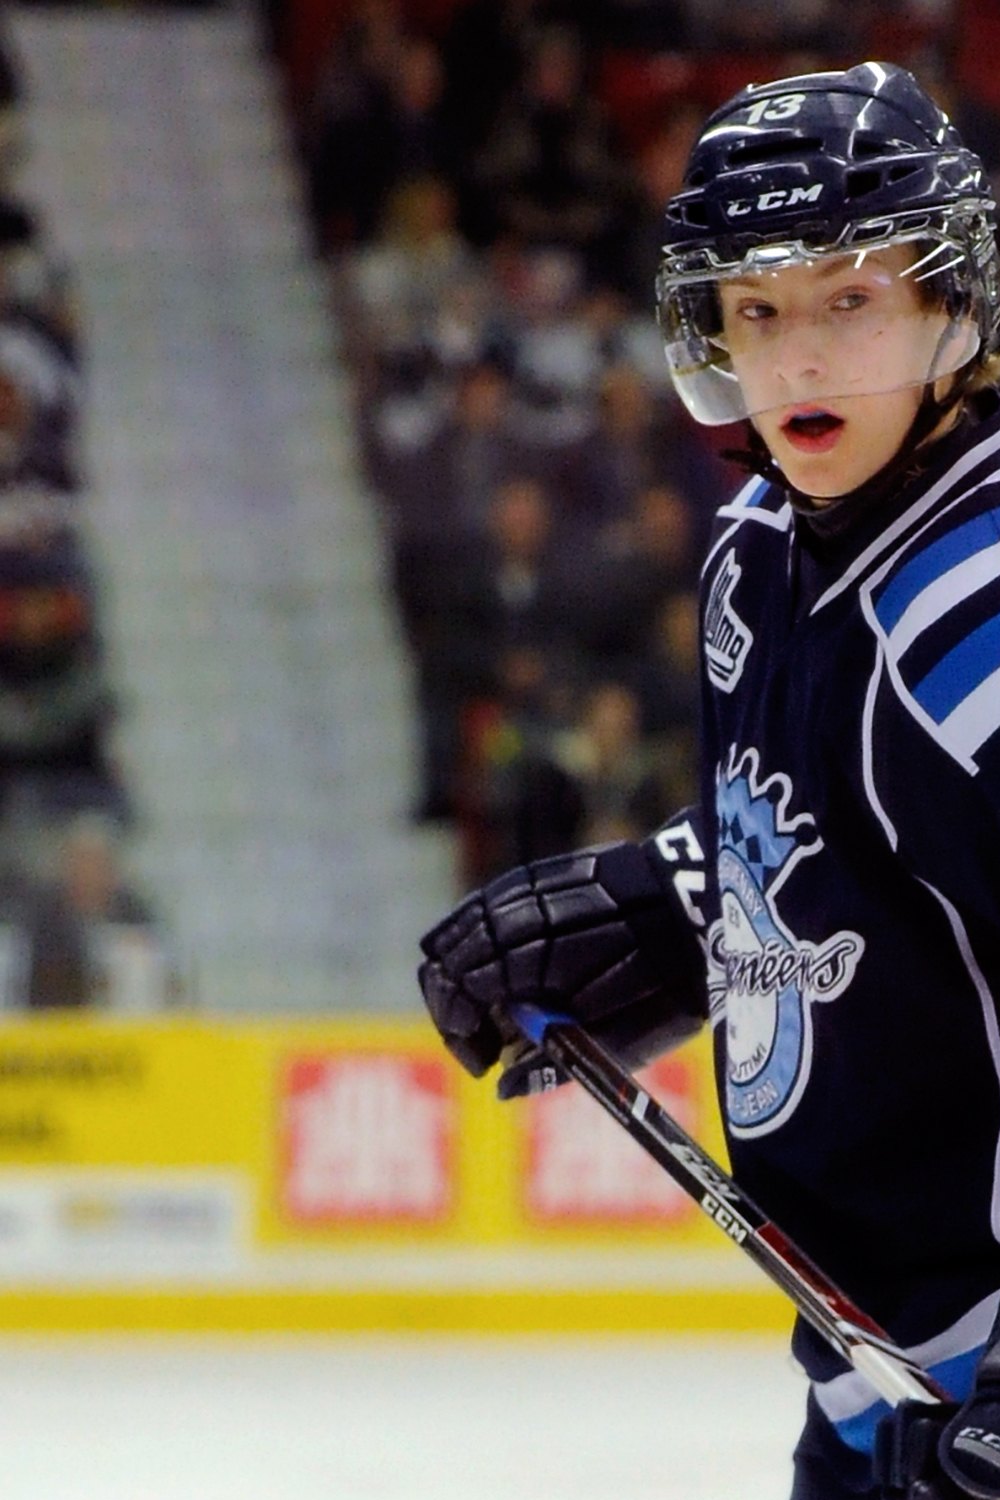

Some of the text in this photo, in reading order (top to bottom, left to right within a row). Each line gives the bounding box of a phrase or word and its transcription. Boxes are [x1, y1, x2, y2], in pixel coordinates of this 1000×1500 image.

[744, 94, 806, 125] 13
[727, 183, 824, 217] CCM
[655, 820, 706, 927] CC
[701, 1193, 749, 1243] CCM
